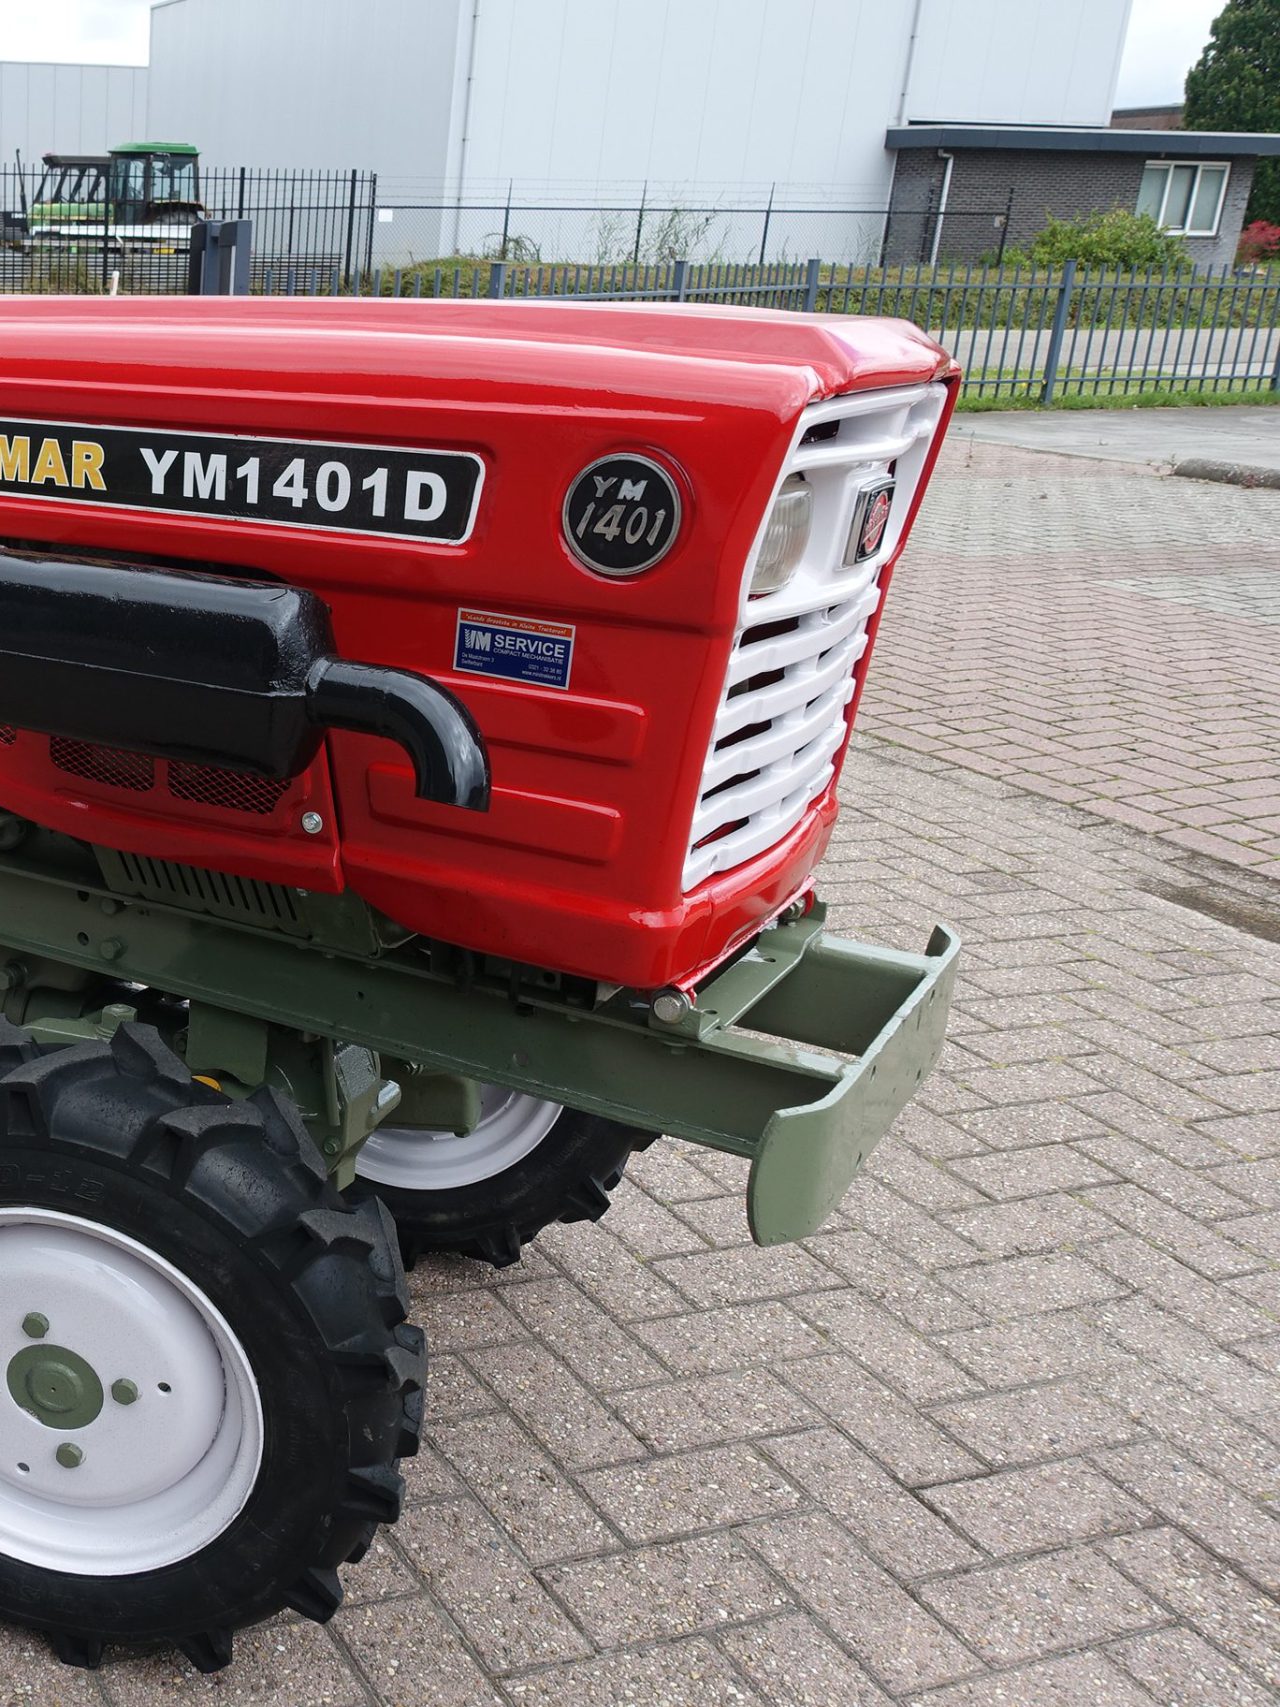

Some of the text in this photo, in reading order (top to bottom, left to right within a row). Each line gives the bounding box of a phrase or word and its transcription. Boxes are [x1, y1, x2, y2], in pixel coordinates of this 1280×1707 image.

[139, 447, 448, 522] YM1401D
[593, 475, 648, 502] YM
[575, 501, 666, 546] 1401
[493, 647, 563, 665] COMPACT MECHANISATIE
[494, 634, 565, 658] SERVICE
